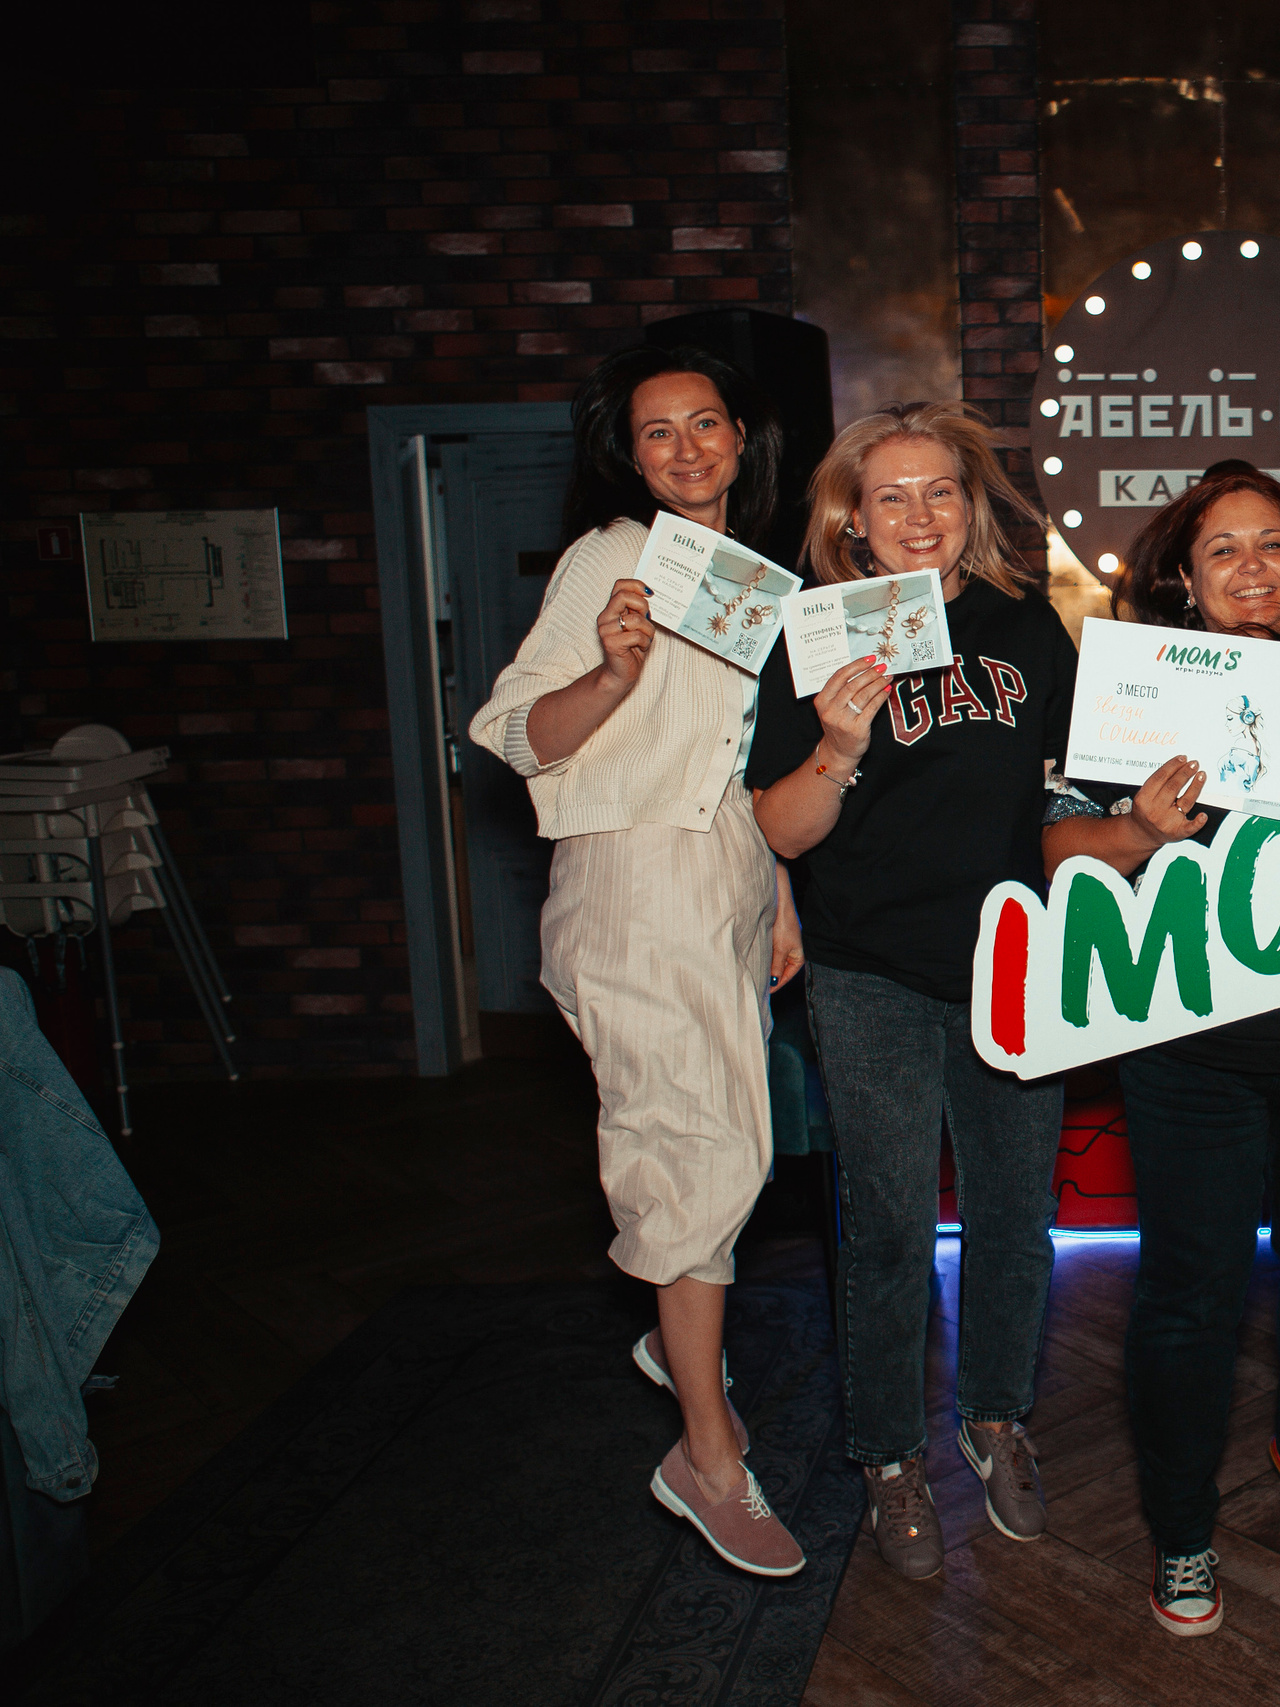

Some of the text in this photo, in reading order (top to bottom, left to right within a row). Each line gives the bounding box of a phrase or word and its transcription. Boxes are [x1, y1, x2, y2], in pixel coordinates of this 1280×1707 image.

[672, 533, 705, 554] Bilka
[657, 554, 701, 578] СЕРТИФИКАТ
[659, 561, 669, 569] НА
[684, 572, 696, 582] РУБ
[803, 602, 834, 616] Bilka
[800, 624, 843, 639] СЕРТИФИКАТ
[1195, 668, 1224, 677] разума
[887, 654, 1028, 746] GAP
[1116, 682, 1159, 699] 3 МЕСТО
